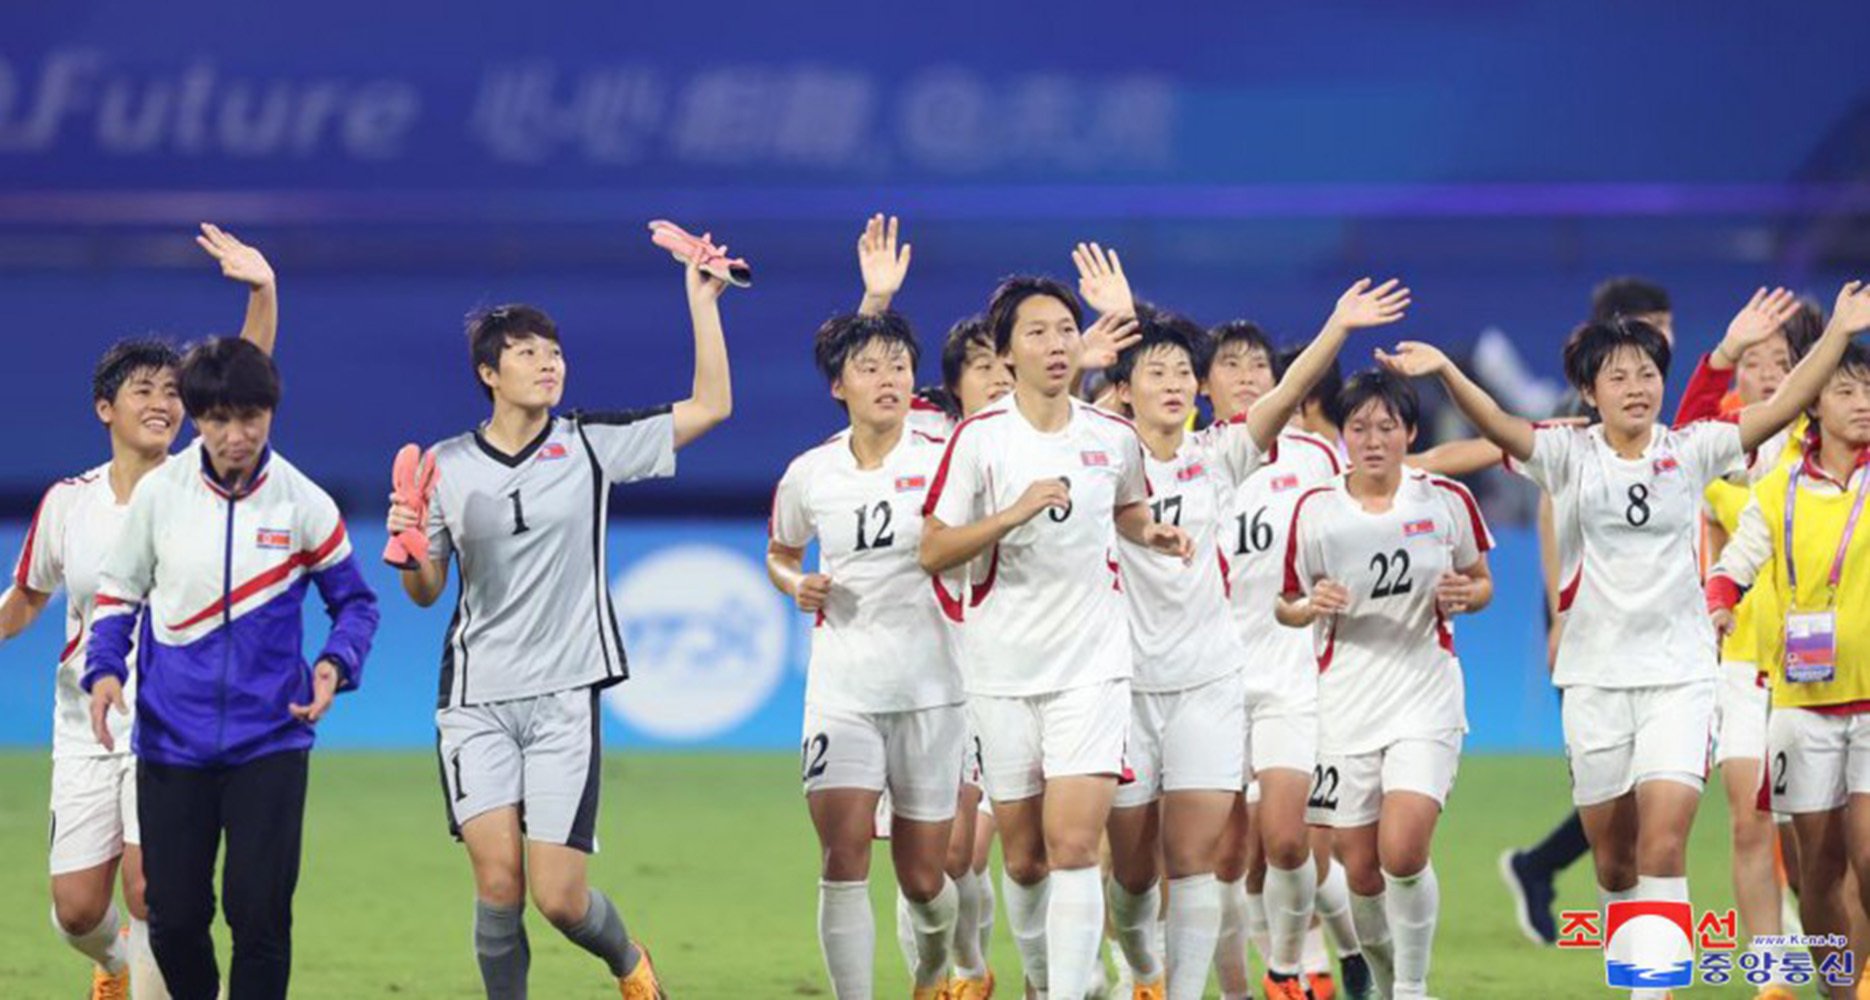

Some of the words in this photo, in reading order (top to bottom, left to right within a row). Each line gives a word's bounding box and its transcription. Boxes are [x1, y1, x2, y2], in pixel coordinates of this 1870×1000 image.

[508, 488, 530, 535] 1
[853, 500, 895, 551] 12
[1626, 483, 1650, 527] 8
[1234, 505, 1273, 556] 16
[1369, 548, 1413, 599] 22
[452, 752, 468, 802] 1
[1307, 763, 1339, 811] 22
